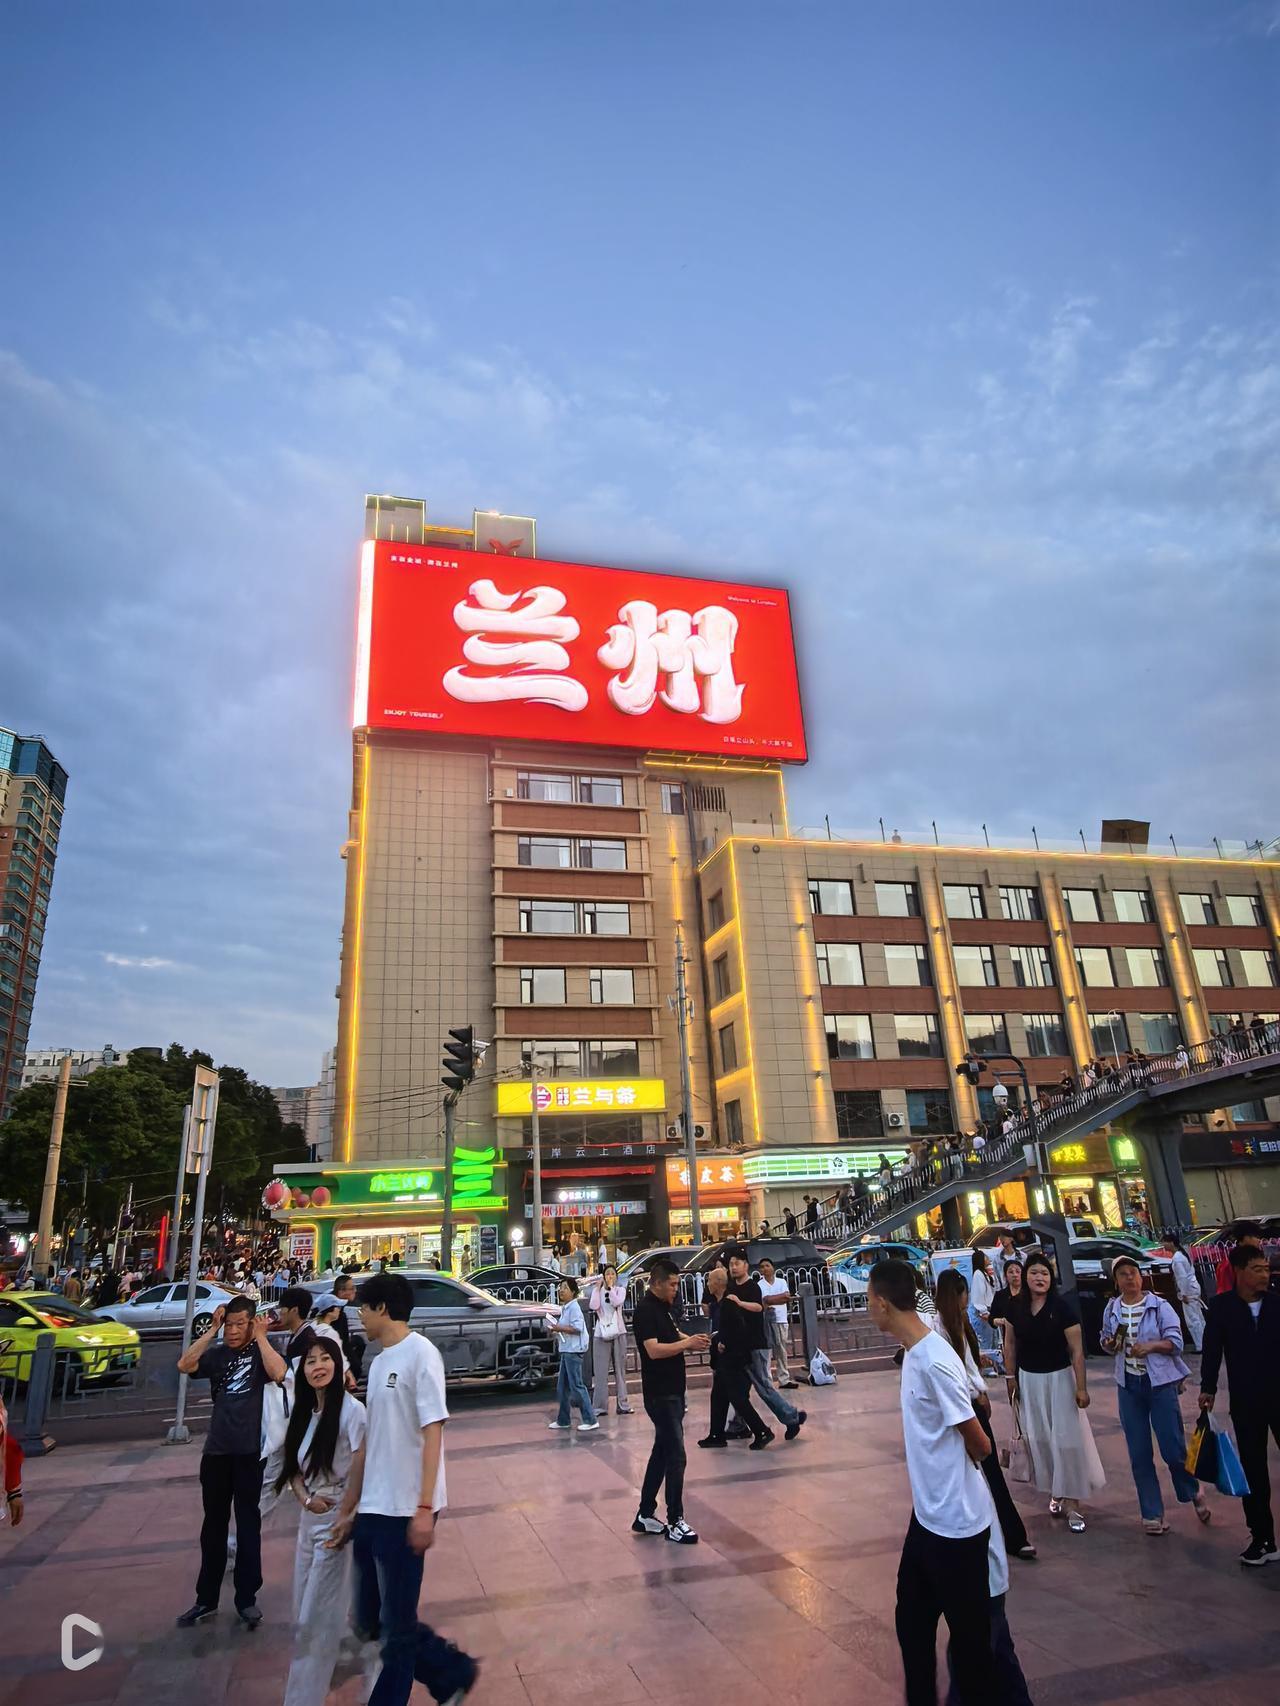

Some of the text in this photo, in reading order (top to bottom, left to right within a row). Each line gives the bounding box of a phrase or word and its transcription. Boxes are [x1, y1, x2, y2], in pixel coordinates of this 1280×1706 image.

[442, 578, 746, 725] 兰州
[572, 1086, 636, 1105] 兰与茶
[527, 1145, 656, 1159] 水岸云上酒店
